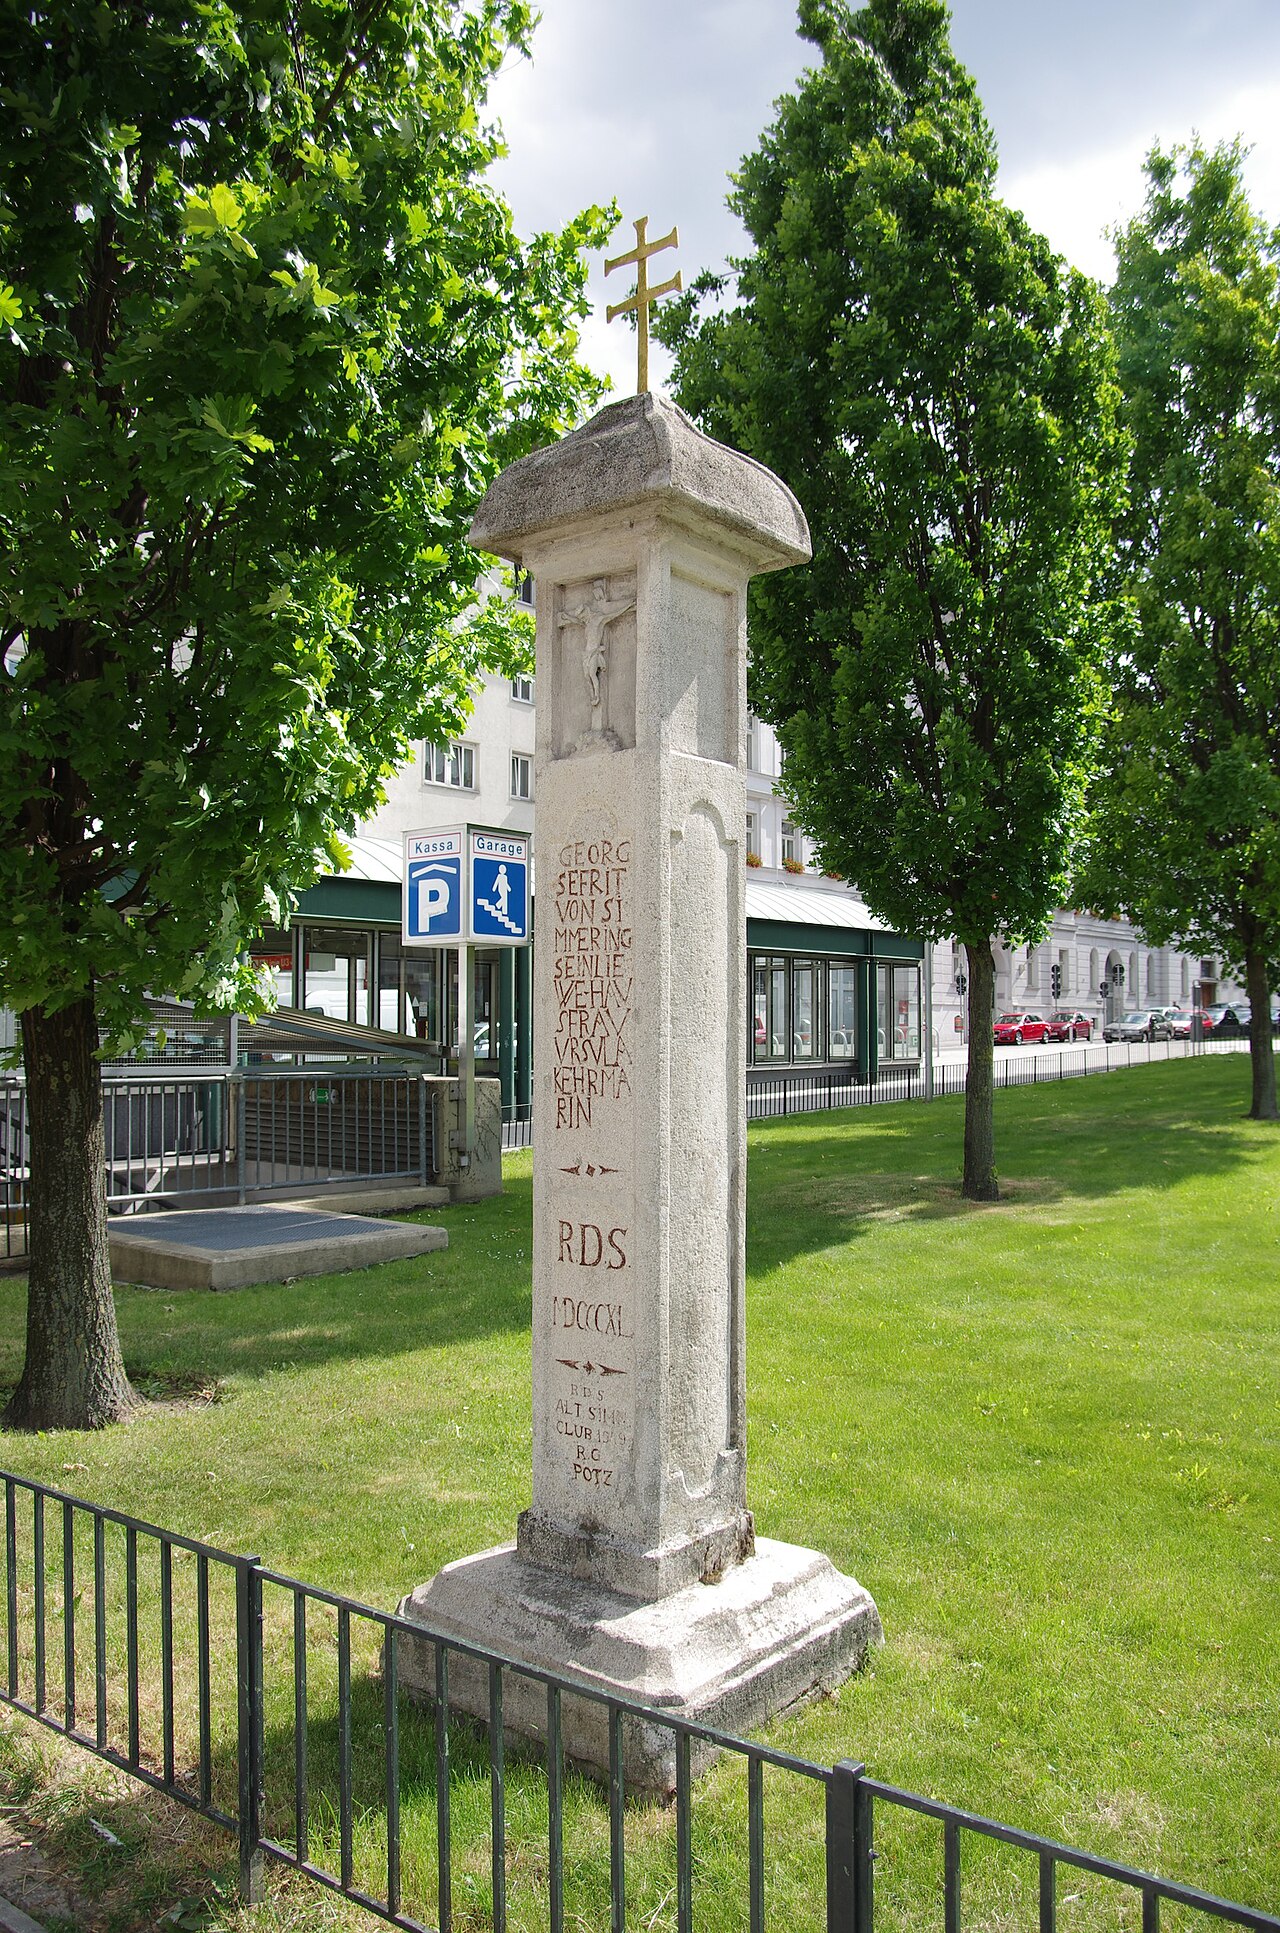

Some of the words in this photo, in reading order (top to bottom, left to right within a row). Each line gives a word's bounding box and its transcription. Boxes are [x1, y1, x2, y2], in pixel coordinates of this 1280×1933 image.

[415, 841, 453, 854] Kassa
[476, 837, 523, 856] Garage
[558, 840, 631, 867] GEORG
[556, 867, 627, 897] SEFRIT
[555, 899, 595, 924] VON
[554, 924, 632, 953] MMERING
[556, 1096, 592, 1129] RIN
[556, 1420, 593, 1441] CLUB
[572, 1462, 613, 1487] POTZ
